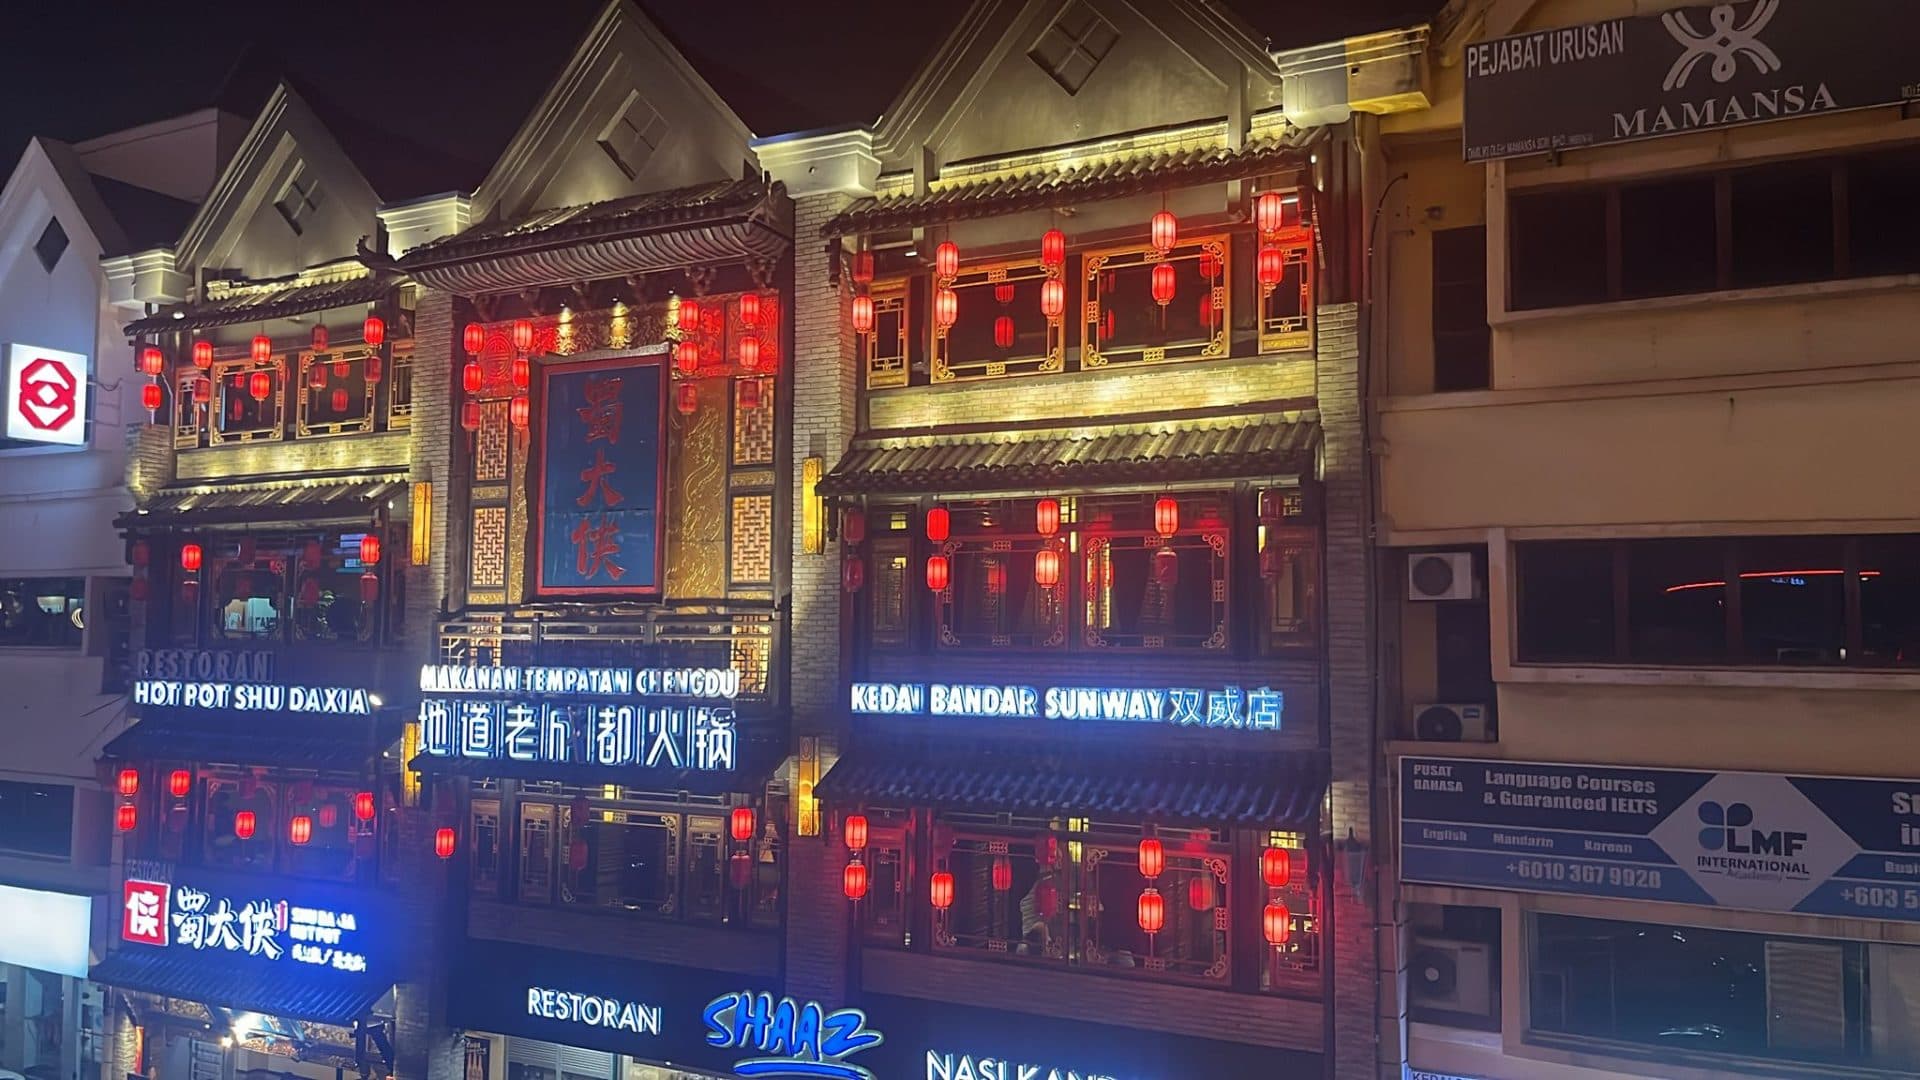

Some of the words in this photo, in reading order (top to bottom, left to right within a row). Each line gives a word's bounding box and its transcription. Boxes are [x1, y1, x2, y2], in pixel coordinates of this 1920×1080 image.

[1467, 34, 1544, 79] PEJABAT
[1549, 20, 1626, 62] URUSAN
[1612, 83, 1839, 139] MAMANSA
[571, 377, 626, 581] 蜀大侠
[137, 650, 274, 682] RESTORAN
[420, 664, 521, 692] MAKANAN
[525, 667, 632, 695] TEMPATAN
[636, 668, 739, 699] CHENGDU
[134, 681, 182, 706] HOT
[184, 683, 230, 709] POT
[234, 685, 285, 711] SHU
[289, 687, 370, 715] DAXIA
[850, 683, 925, 714] KEDAI
[930, 684, 1038, 718] BANDAR
[1044, 687, 1166, 722] SUNWAY
[1167, 687, 1284, 731] 双威店
[1413, 763, 1453, 777] PUSAT
[1413, 779, 1464, 792] BAHASA
[1485, 769, 1573, 790] Language
[1576, 774, 1656, 793] Courses
[1484, 792, 1496, 805] &
[1500, 791, 1607, 812] Guaranteed
[1611, 797, 1658, 816] IELTS
[1423, 827, 1468, 842] English
[1493, 833, 1554, 848] Mandarin
[1584, 839, 1633, 854] Korean
[1726, 828, 1807, 857] LMF
[1506, 859, 1565, 880] +6010
[1569, 863, 1605, 884] 367
[1697, 856, 1810, 875] INTERNATIONAL
[1840, 886, 1898, 908] +603
[1904, 889, 1920, 909] 5
[171, 885, 285, 961] 蜀大侠
[527, 986, 662, 1035] RESTORAN
[703, 989, 884, 1063] SHAAZ
[926, 1049, 1008, 1080] NASI
